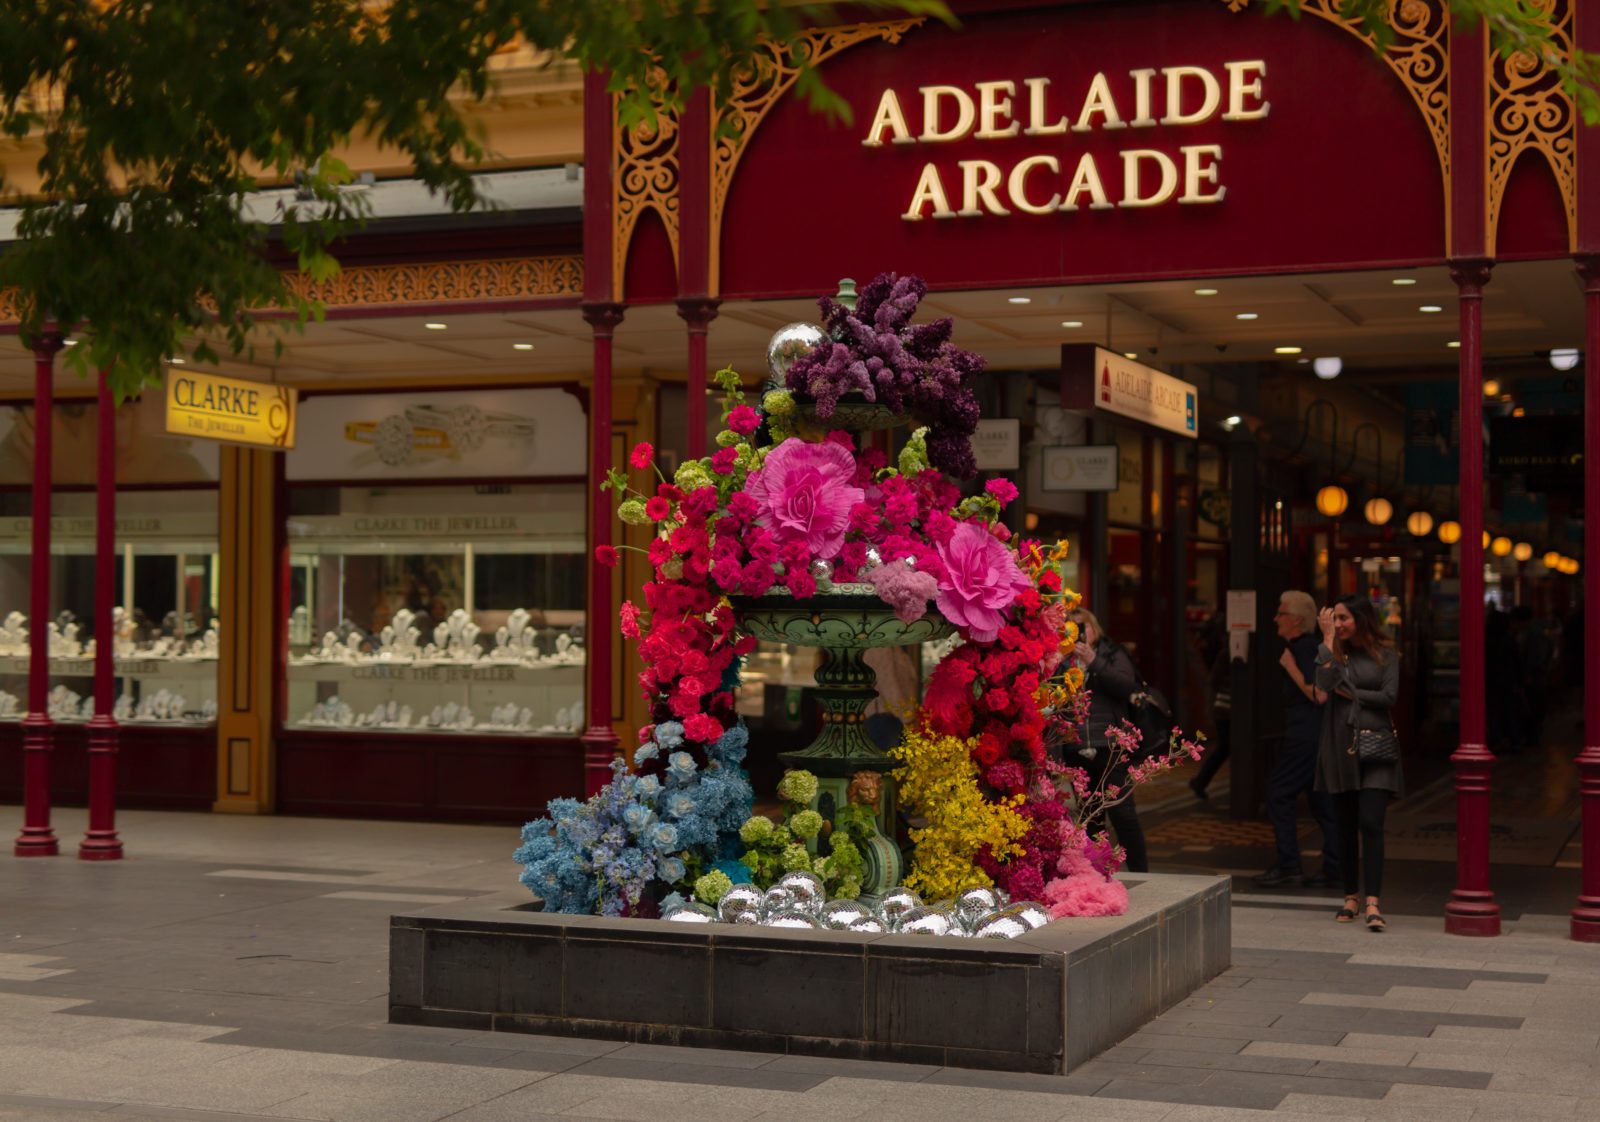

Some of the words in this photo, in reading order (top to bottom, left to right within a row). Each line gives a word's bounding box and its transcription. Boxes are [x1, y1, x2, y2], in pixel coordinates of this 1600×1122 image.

[862, 60, 1271, 147] ADELAIDE
[901, 144, 1227, 221] ARCADE
[174, 378, 259, 416] CLARKE
[1115, 371, 1152, 402] ADELAIDE
[1154, 384, 1182, 413] ARCADE
[14, 519, 63, 532] CLKE
[114, 518, 161, 531] WELLER
[354, 518, 408, 531] CLARKE
[413, 518, 442, 531] THE
[447, 517, 518, 532] JEWELLER
[352, 668, 405, 680] CLARKE
[413, 667, 441, 680] THE
[446, 667, 516, 682] JEWELLER
